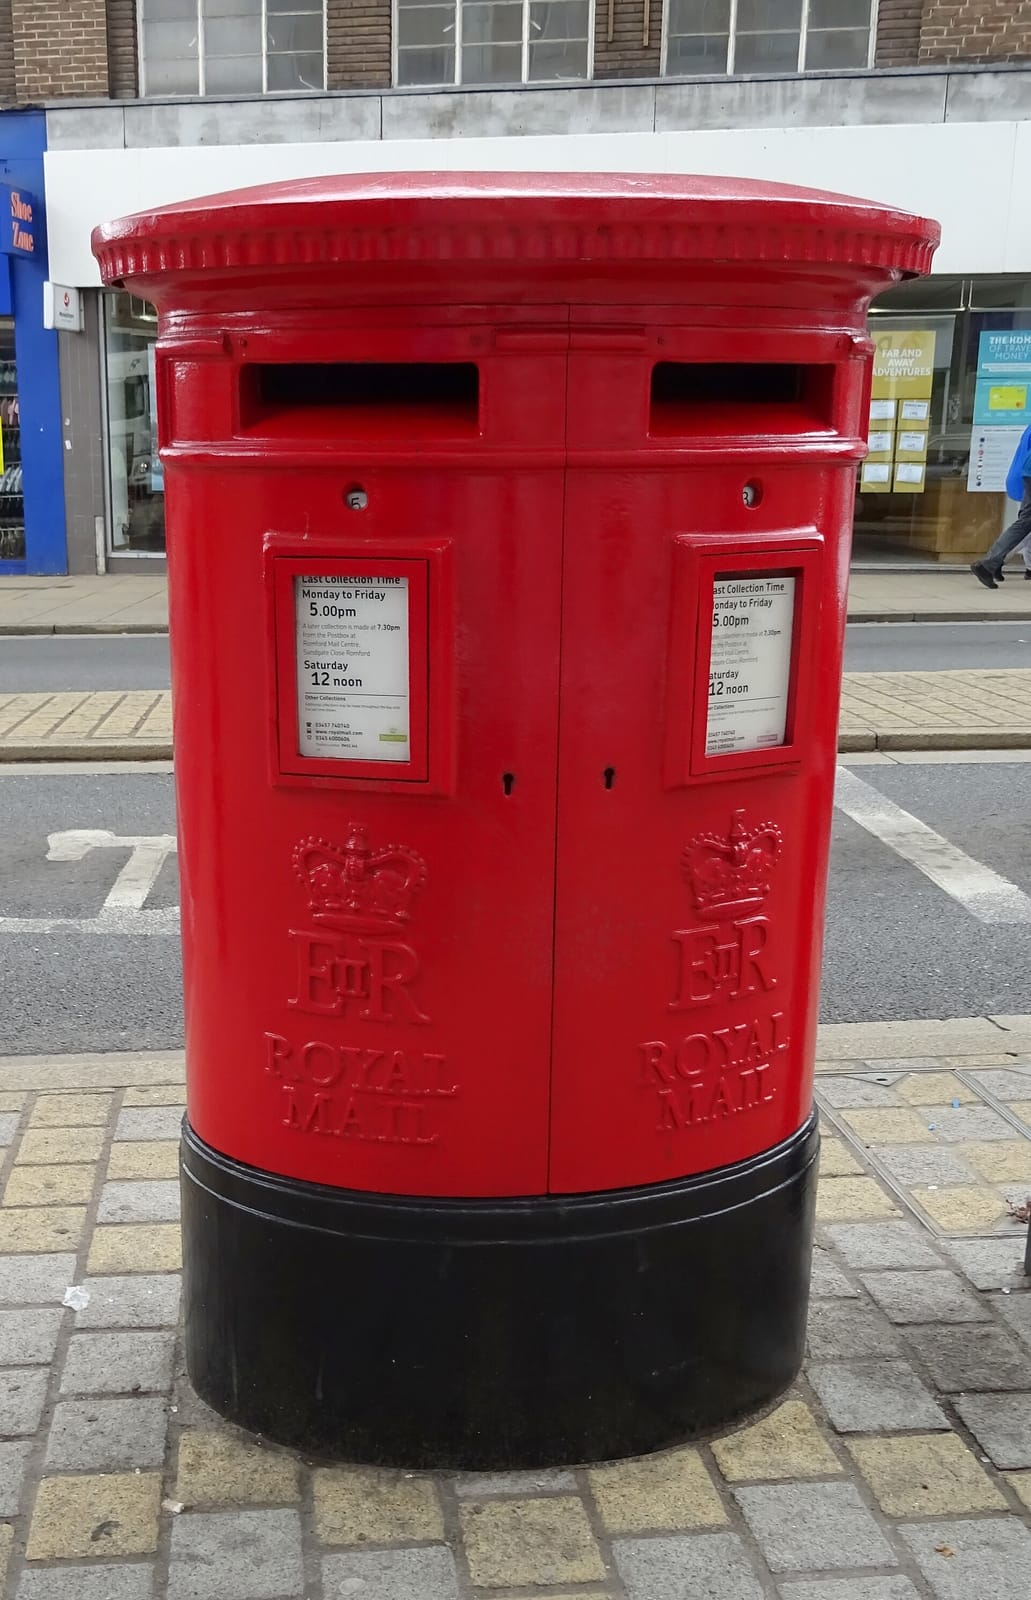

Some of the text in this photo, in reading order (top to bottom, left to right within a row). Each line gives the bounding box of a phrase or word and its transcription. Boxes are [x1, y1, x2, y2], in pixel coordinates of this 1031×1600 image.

[11, 191, 33, 223] Shoe
[12, 221, 34, 253] Zone
[989, 336, 1008, 345] THE
[882, 348, 922, 358] FAR AND
[989, 345, 1002, 353] OF
[887, 358, 915, 367] AWAY
[994, 352, 1028, 361] MONEY
[302, 576, 401, 585] Last Collection Time
[713, 582, 785, 594] ast Collection Time
[302, 589, 386, 601] Monday to Friday
[714, 598, 773, 610] onday to Friday
[309, 602, 356, 619] 5.00pm
[712, 613, 749, 628] 5.00pm
[377, 623, 401, 631] 7.30pm
[304, 660, 348, 672] Saturday
[311, 672, 362, 687] 12 noon
[709, 670, 739, 680] aturday
[708, 681, 749, 696] 12 noon
[639, 1012, 790, 1085] ROYAL
[263, 1032, 461, 1097] ROYAL
[656, 1064, 778, 1131] MAIL
[282, 1085, 440, 1144] MAIL
